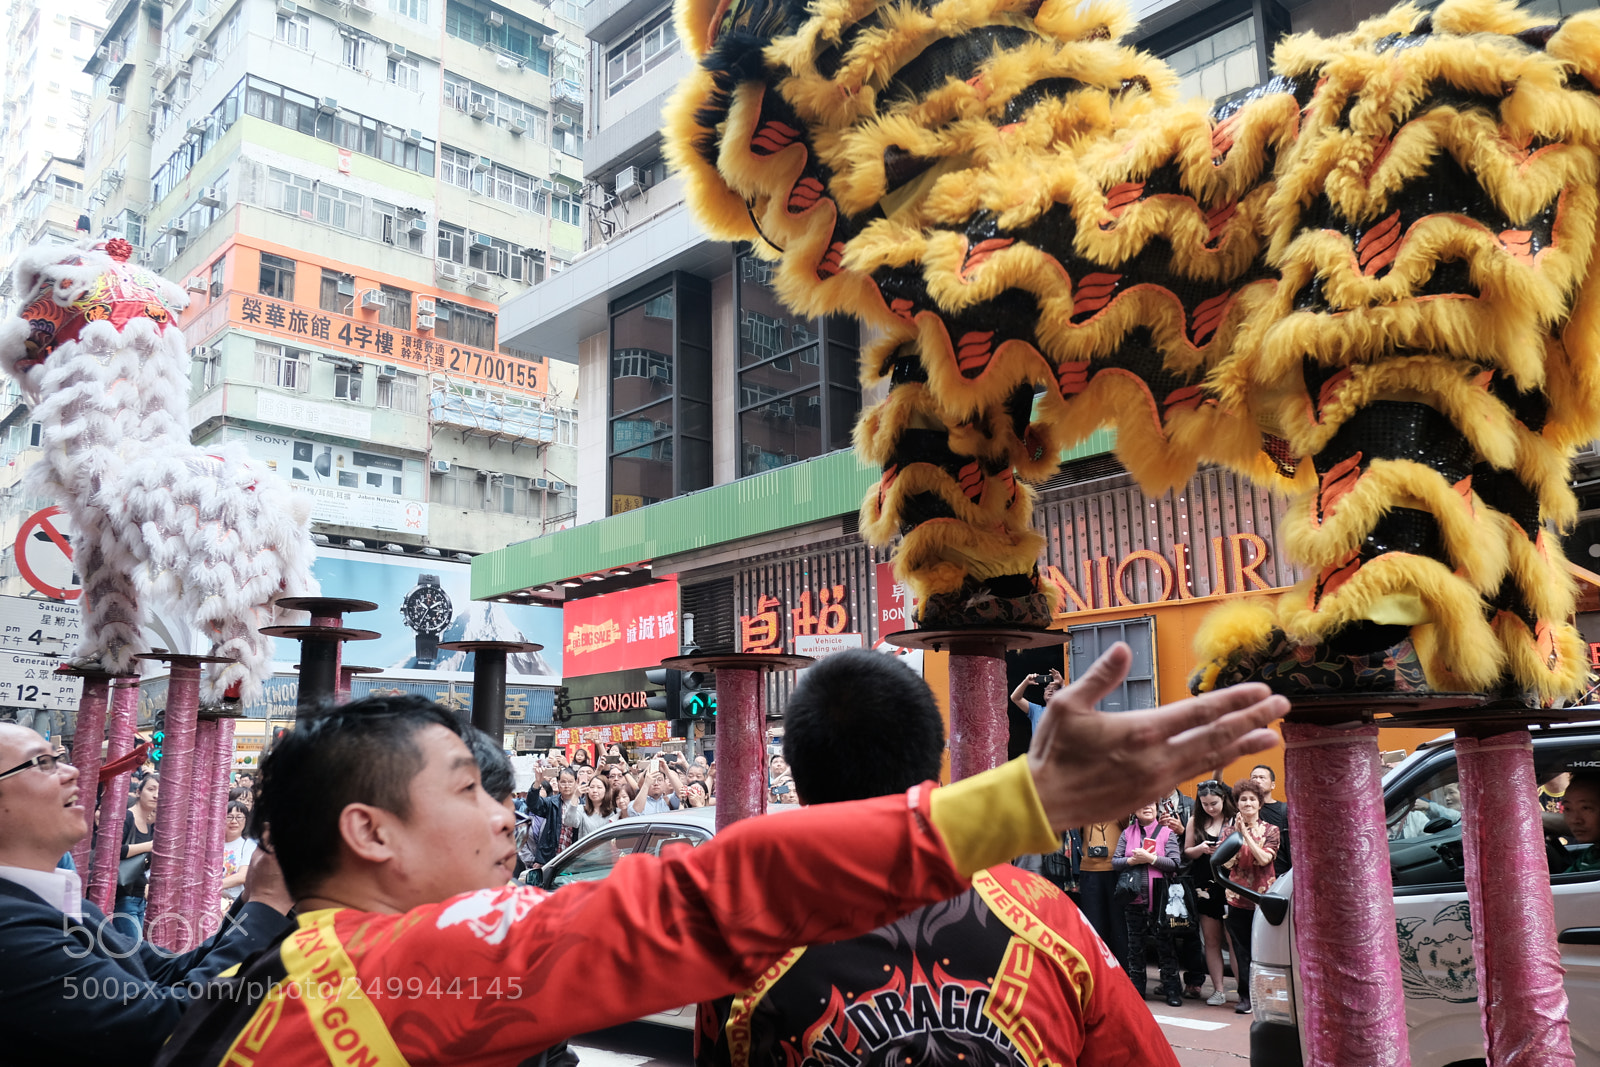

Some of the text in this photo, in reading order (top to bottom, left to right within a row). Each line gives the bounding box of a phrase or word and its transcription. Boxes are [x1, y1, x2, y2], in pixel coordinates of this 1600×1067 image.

[241, 297, 331, 342] 榮華旅館
[338, 322, 394, 355] 4字樓
[450, 347, 537, 388] 27700155
[255, 434, 289, 446] SONY
[377, 496, 400, 504] Network
[38, 603, 80, 615] Saturday
[40, 614, 79, 628] 星期六
[0, 634, 22, 646] 下午
[581, 631, 594, 647] BIG
[12, 655, 49, 667] General
[55, 696, 76, 706] 下午
[593, 691, 647, 712] BONJOUR
[977, 876, 1040, 933] FIERY
[1038, 931, 1089, 985] DRAG
